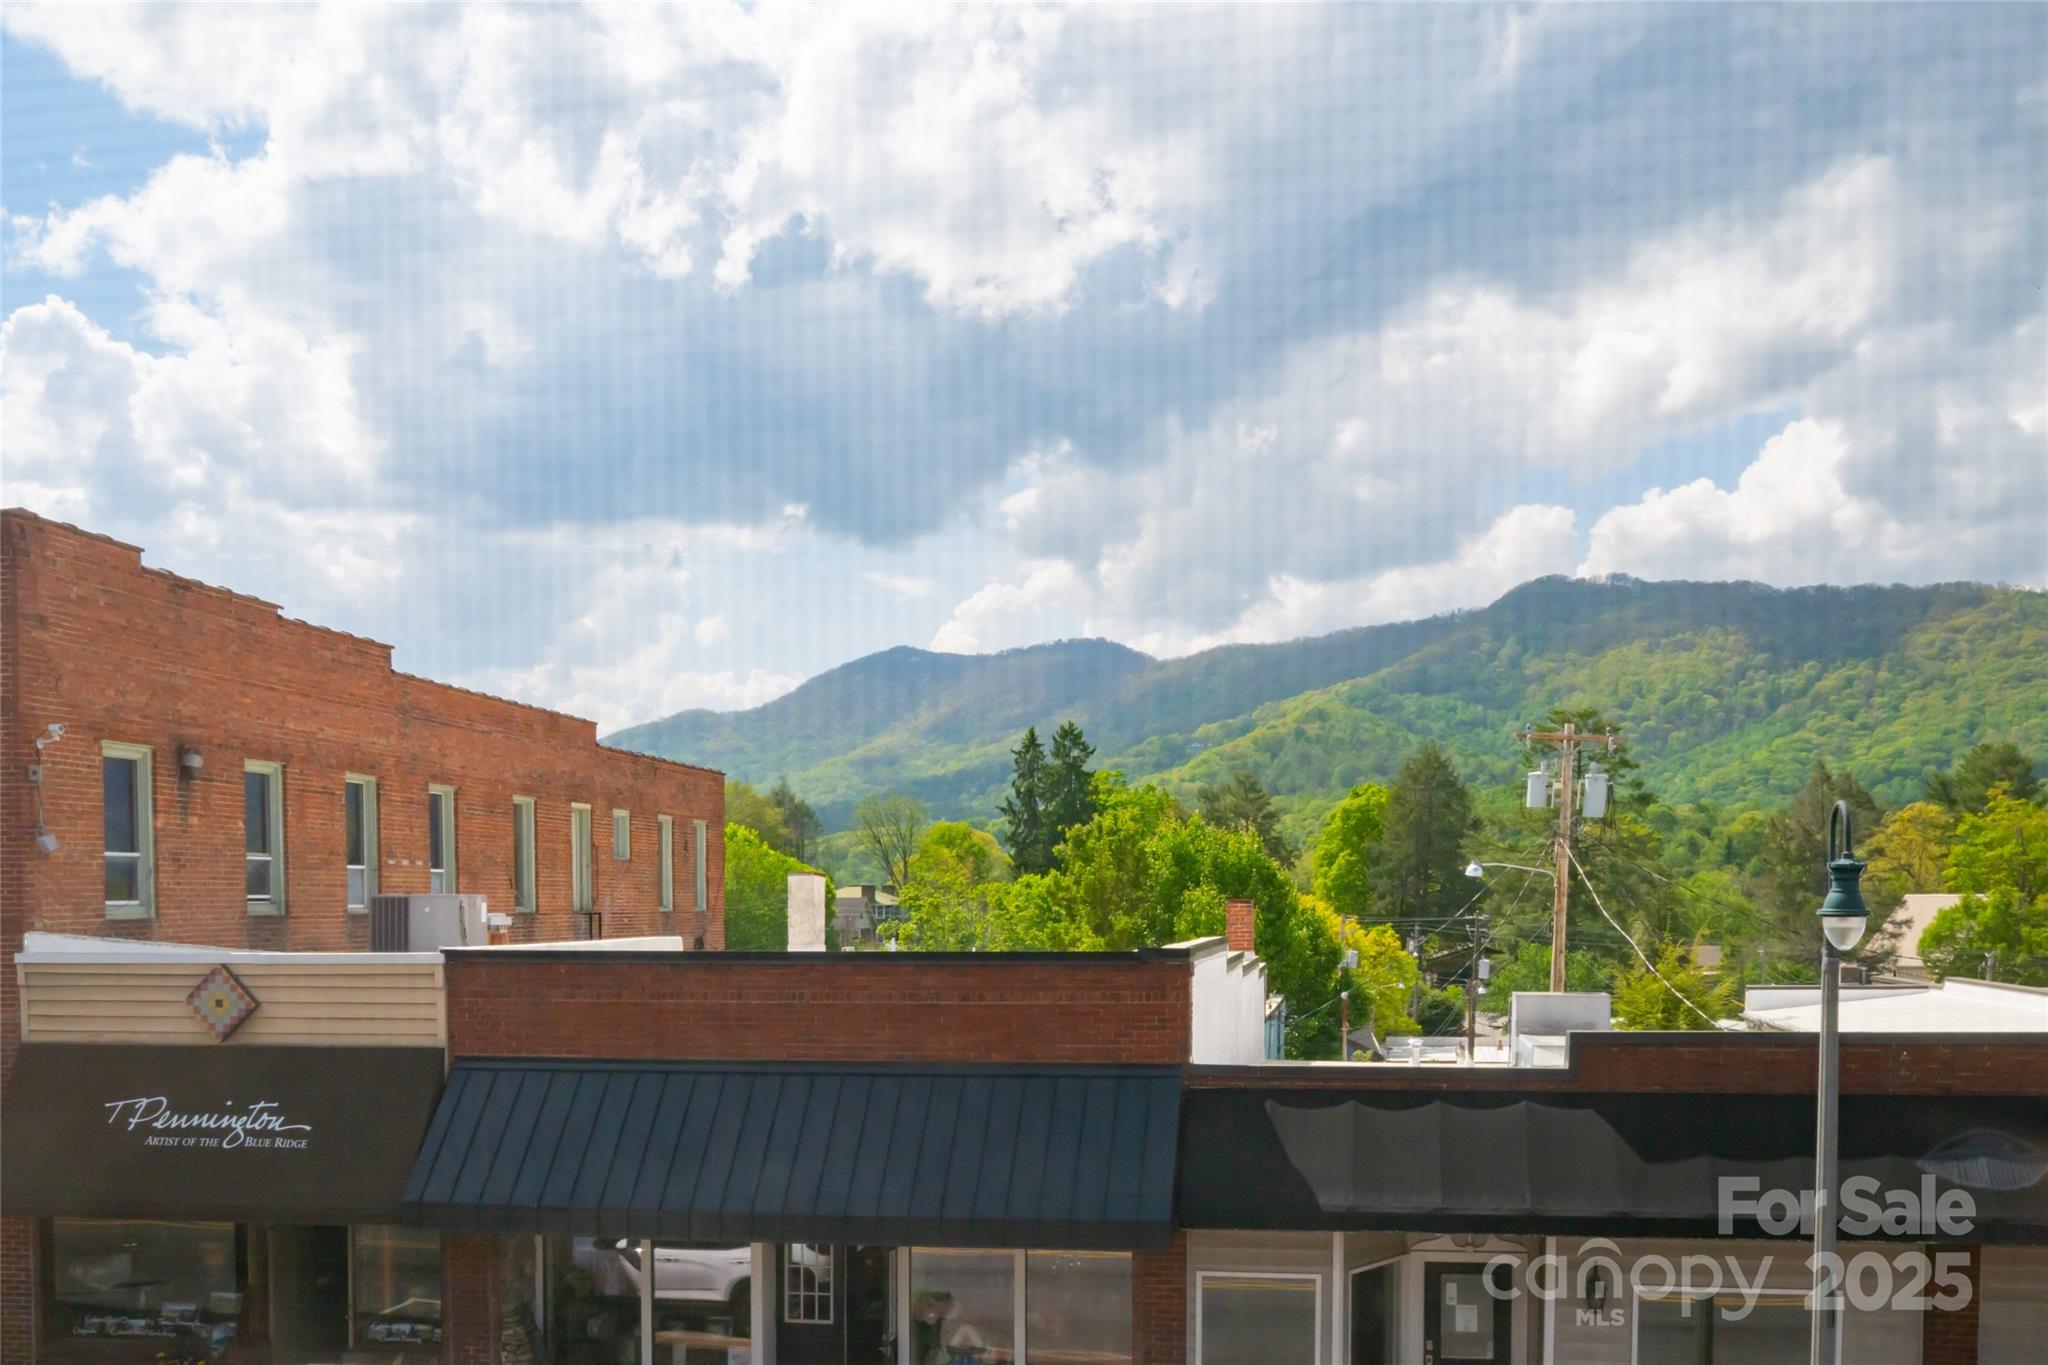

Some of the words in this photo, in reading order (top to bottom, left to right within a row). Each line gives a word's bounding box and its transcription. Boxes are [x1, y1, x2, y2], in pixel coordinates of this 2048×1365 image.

[144, 1135, 181, 1146] ARTIST
[182, 1137, 197, 1147] OF
[199, 1137, 219, 1147] THE
[245, 1137, 271, 1148] BLUE
[274, 1136, 308, 1149] RIDGE
